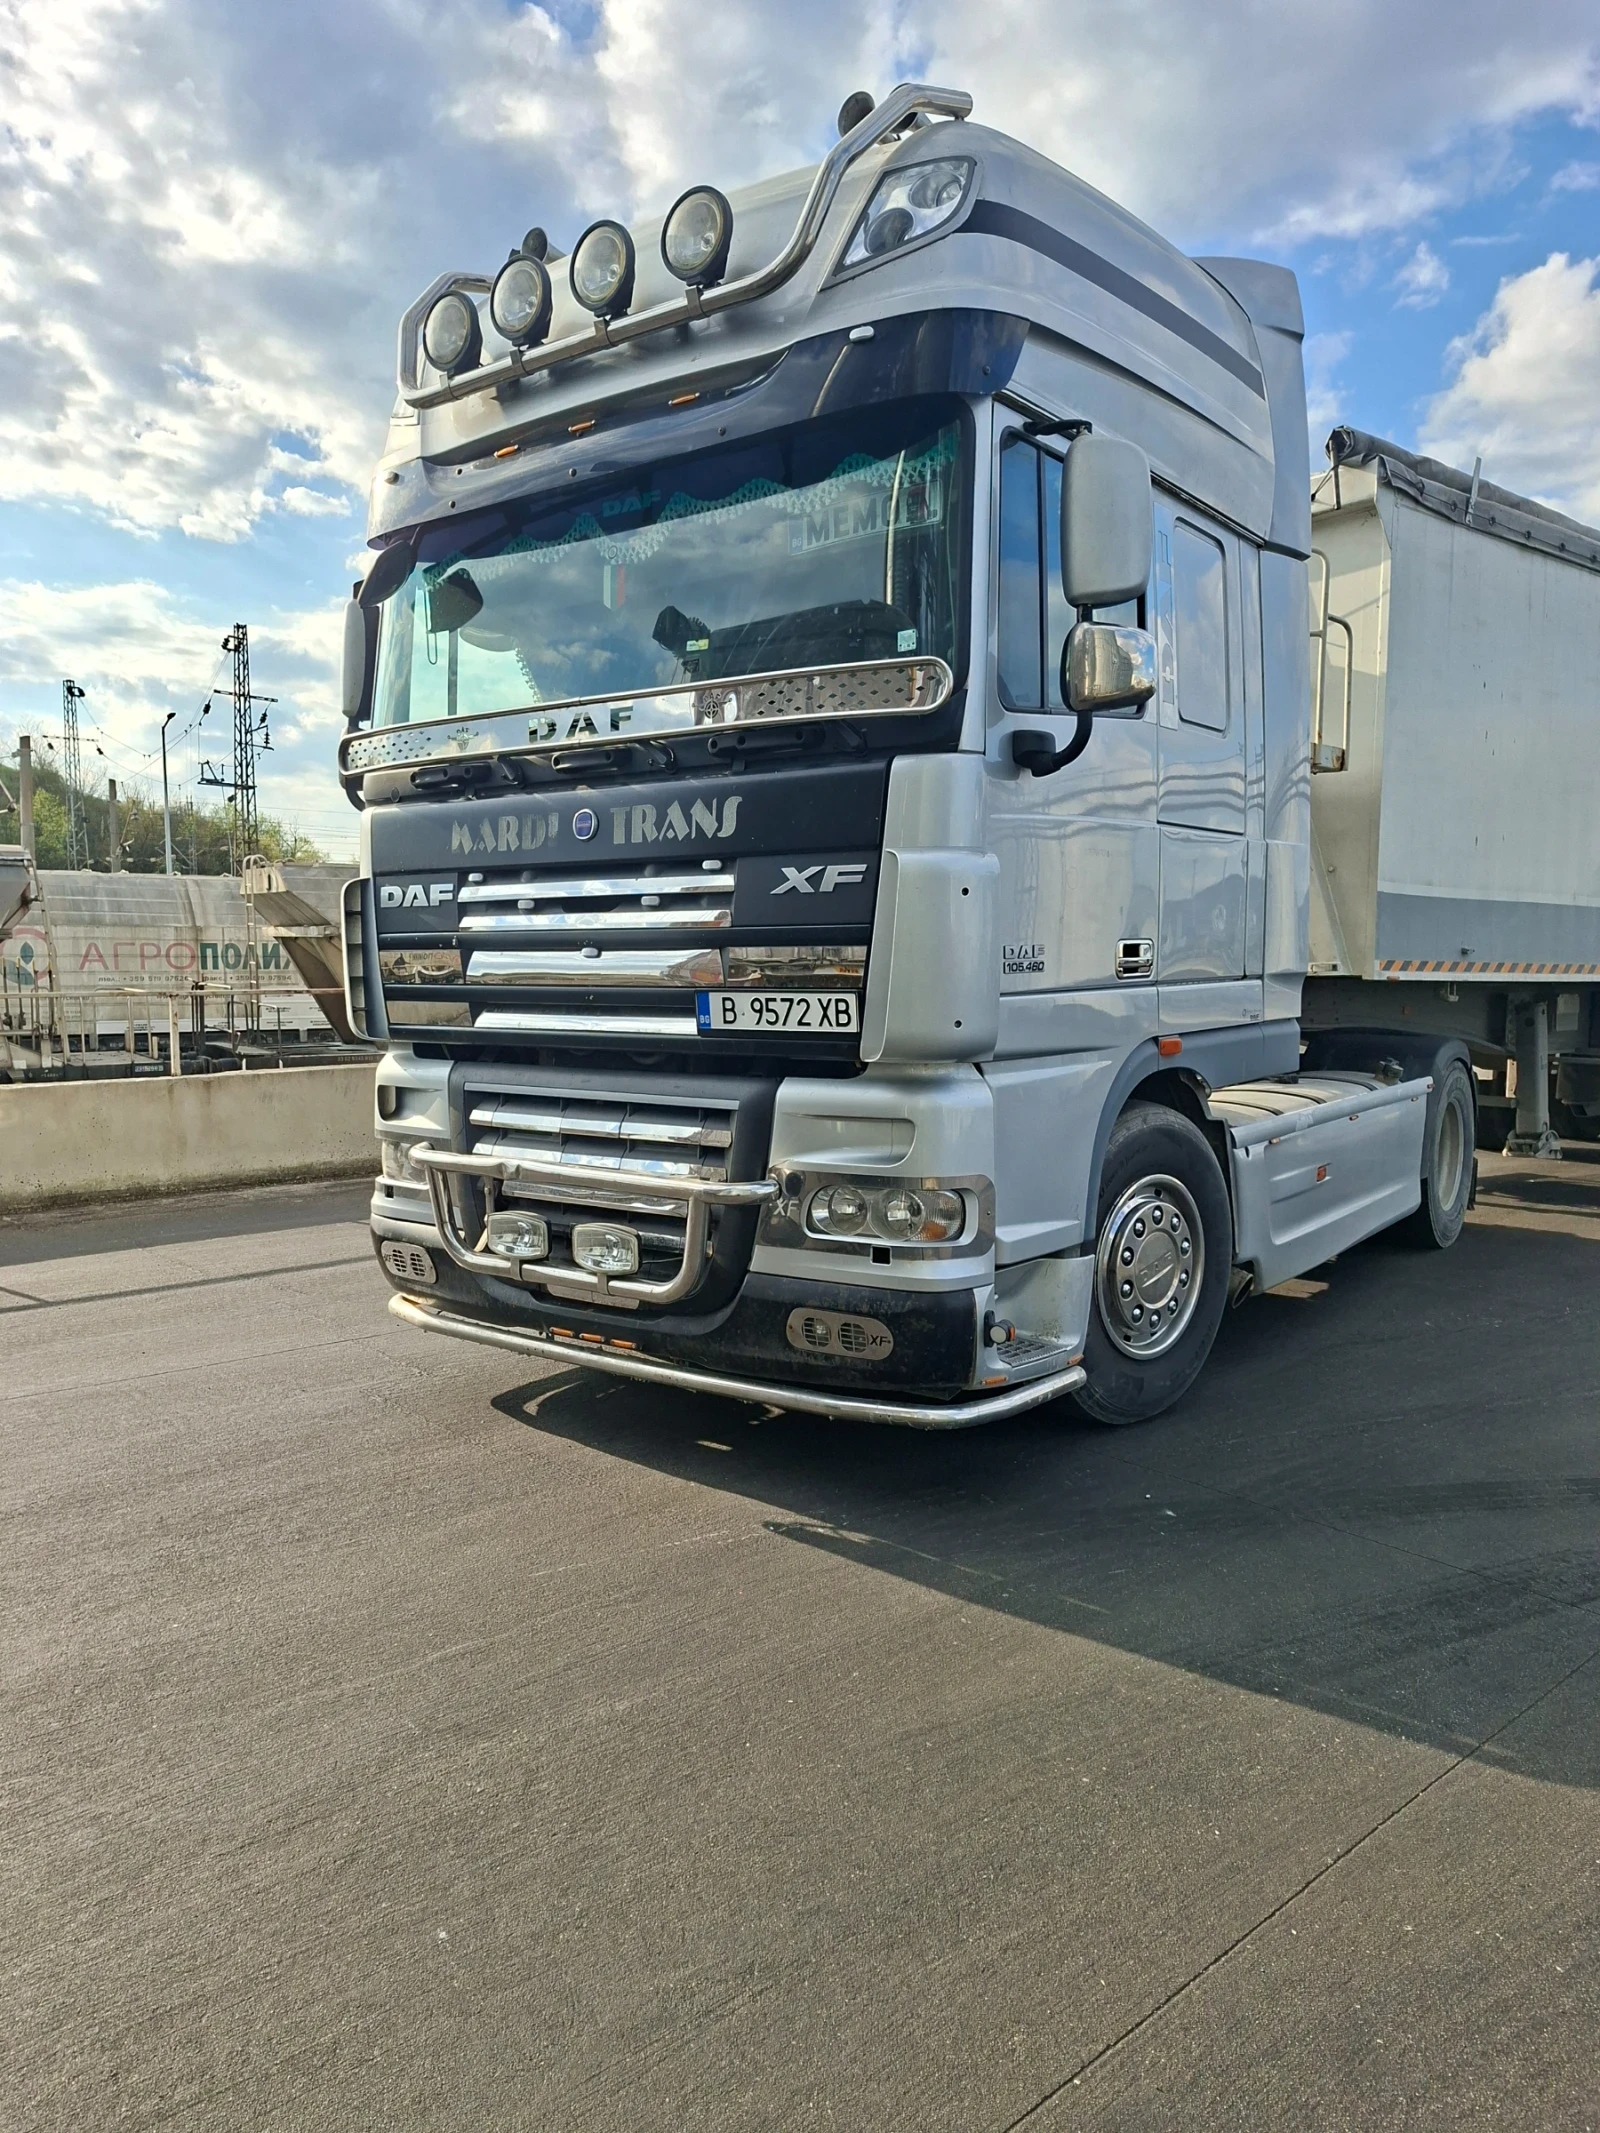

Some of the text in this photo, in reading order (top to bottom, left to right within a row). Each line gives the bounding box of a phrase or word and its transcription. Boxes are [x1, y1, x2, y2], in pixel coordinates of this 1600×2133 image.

[602, 490, 660, 517] DAF
[529, 705, 634, 743] DAF
[610, 796, 743, 845] TRANS
[769, 863, 868, 894] XF
[380, 883, 454, 908] DAF
[1003, 944, 1045, 960] DAF
[1006, 961, 1045, 973] 105.460
[700, 1014, 710, 1024] BG
[721, 997, 852, 1028] B 9572 XB
[773, 1199, 800, 1217] XF
[869, 1334, 888, 1347] XF
